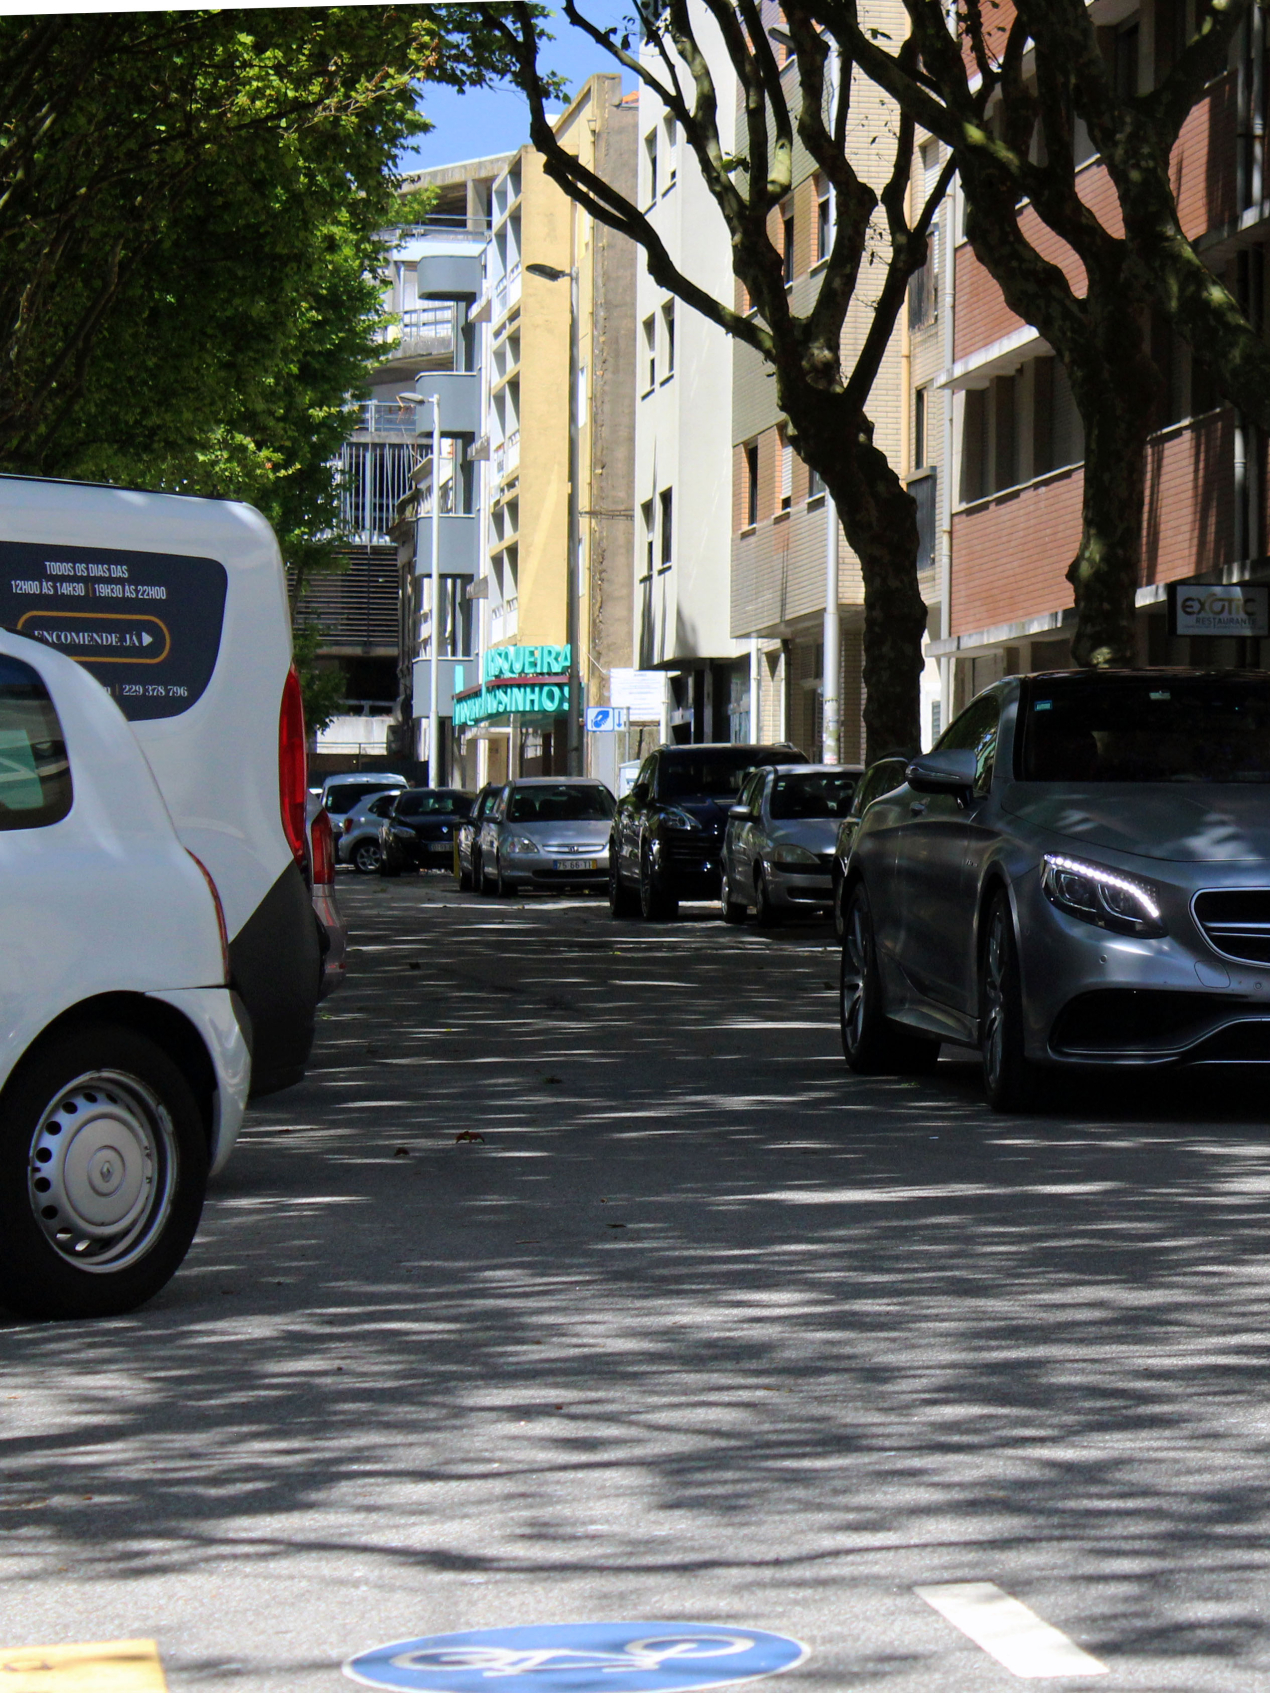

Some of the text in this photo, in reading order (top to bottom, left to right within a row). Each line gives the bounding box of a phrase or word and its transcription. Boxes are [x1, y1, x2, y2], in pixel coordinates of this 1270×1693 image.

[45, 562, 128, 578] TODOS OS DIAS DAS
[11, 579, 85, 596] 12H00 ÀS 14H30
[94, 583, 166, 599] 19H30 ÀS 22H00
[1195, 617, 1258, 628] RESTAURANTE
[123, 631, 140, 647] JÁ
[122, 685, 143, 696] 229
[145, 686, 165, 697] 378
[167, 686, 188, 697] 796
